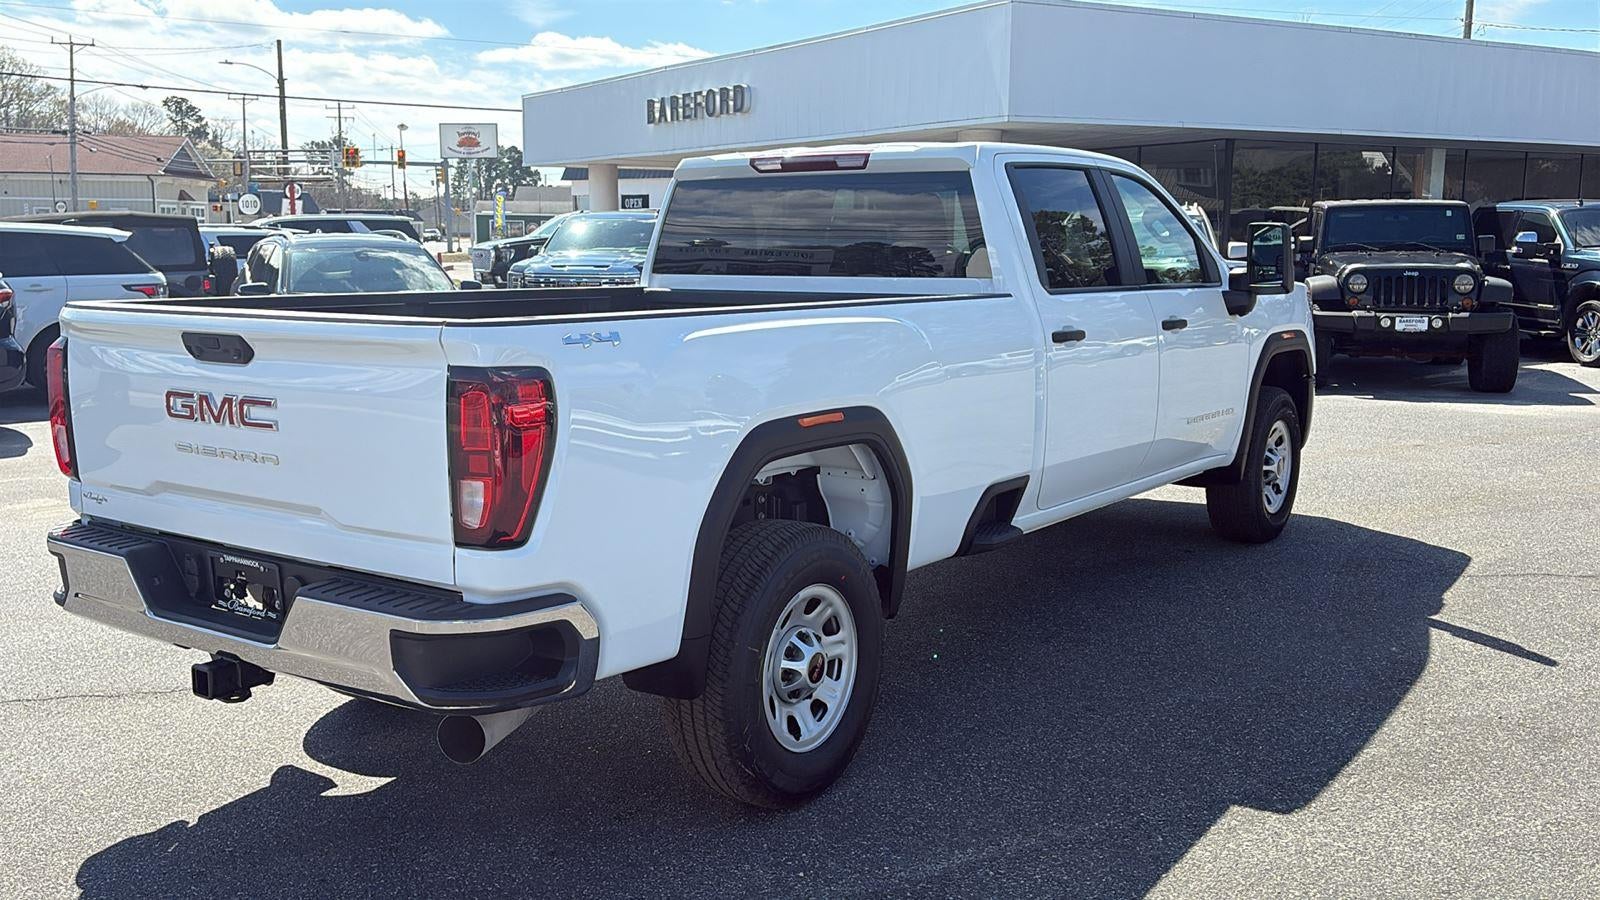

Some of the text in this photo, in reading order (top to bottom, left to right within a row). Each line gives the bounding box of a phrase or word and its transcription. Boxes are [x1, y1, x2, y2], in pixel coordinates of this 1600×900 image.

[646, 83, 752, 125] BAREFORD
[241, 199, 258, 209] 1010
[624, 198, 643, 208] OPEN
[164, 387, 279, 432] GMC
[174, 440, 280, 466] SIERRA
[223, 554, 260, 568] TAPPAHANNOCK
[227, 599, 267, 617] Bareford
